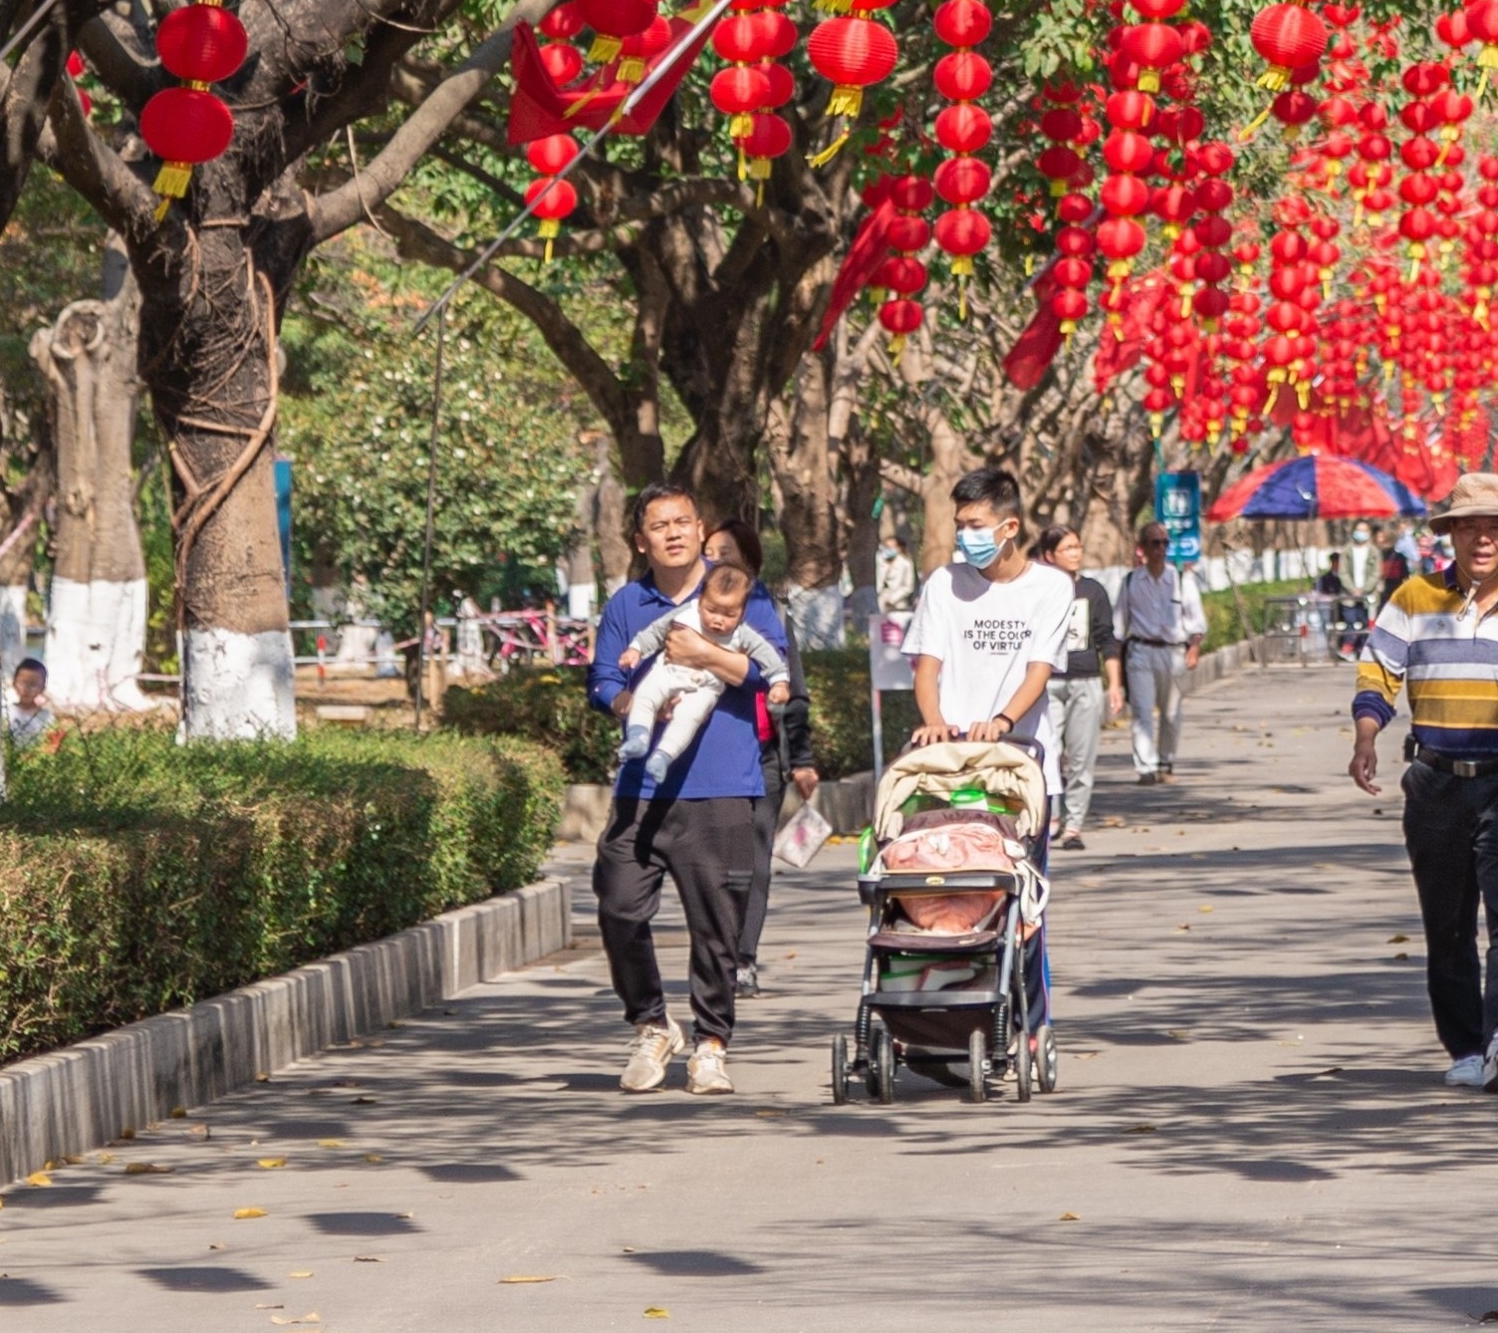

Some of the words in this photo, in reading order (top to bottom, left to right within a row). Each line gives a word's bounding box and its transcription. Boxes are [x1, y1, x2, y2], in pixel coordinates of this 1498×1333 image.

[973, 619, 1026, 629] MODESTY
[964, 630, 974, 639] IS
[977, 630, 996, 640] THE
[998, 629, 1032, 640] COLOR
[973, 640, 987, 650] OF
